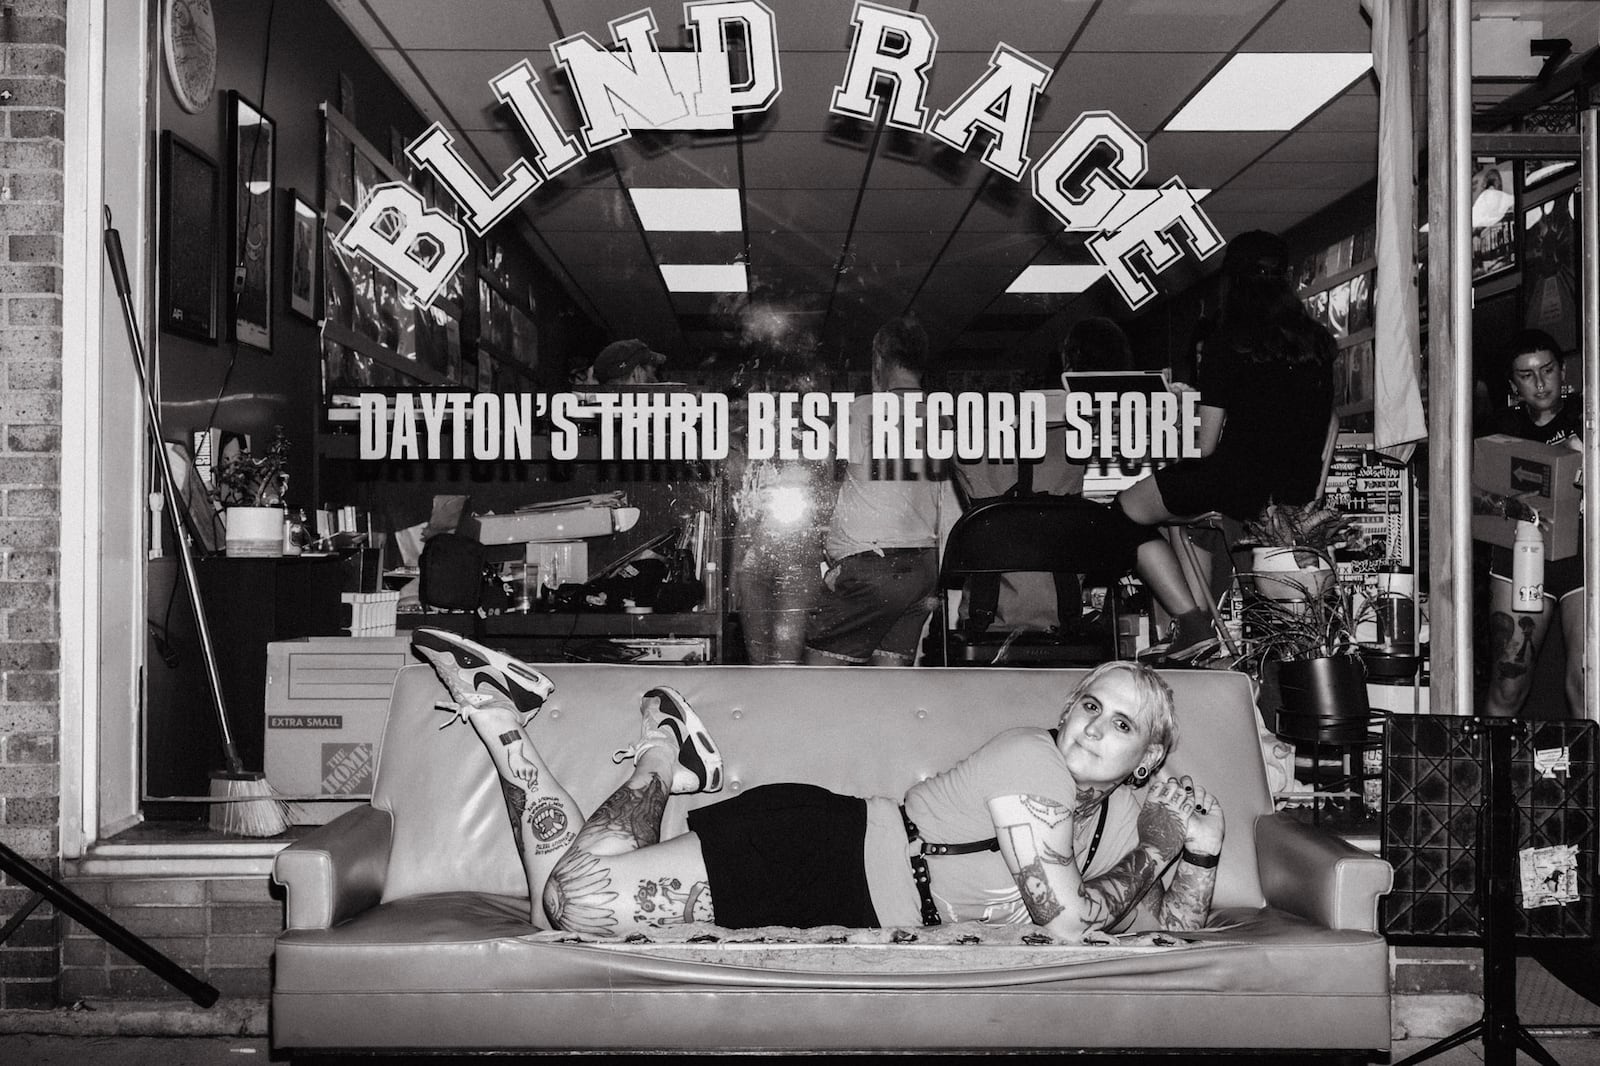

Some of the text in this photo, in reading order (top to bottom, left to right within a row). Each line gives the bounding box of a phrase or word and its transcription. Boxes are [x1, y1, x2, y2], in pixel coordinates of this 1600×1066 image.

[333, 0, 1227, 311] BLIND RAGE
[359, 391, 1202, 461] DAYTON'S THIRD BEST RECORD STORE
[271, 717, 339, 728] EXTRA SMALL
[321, 743, 372, 794] HOME
[326, 747, 346, 769] THE
